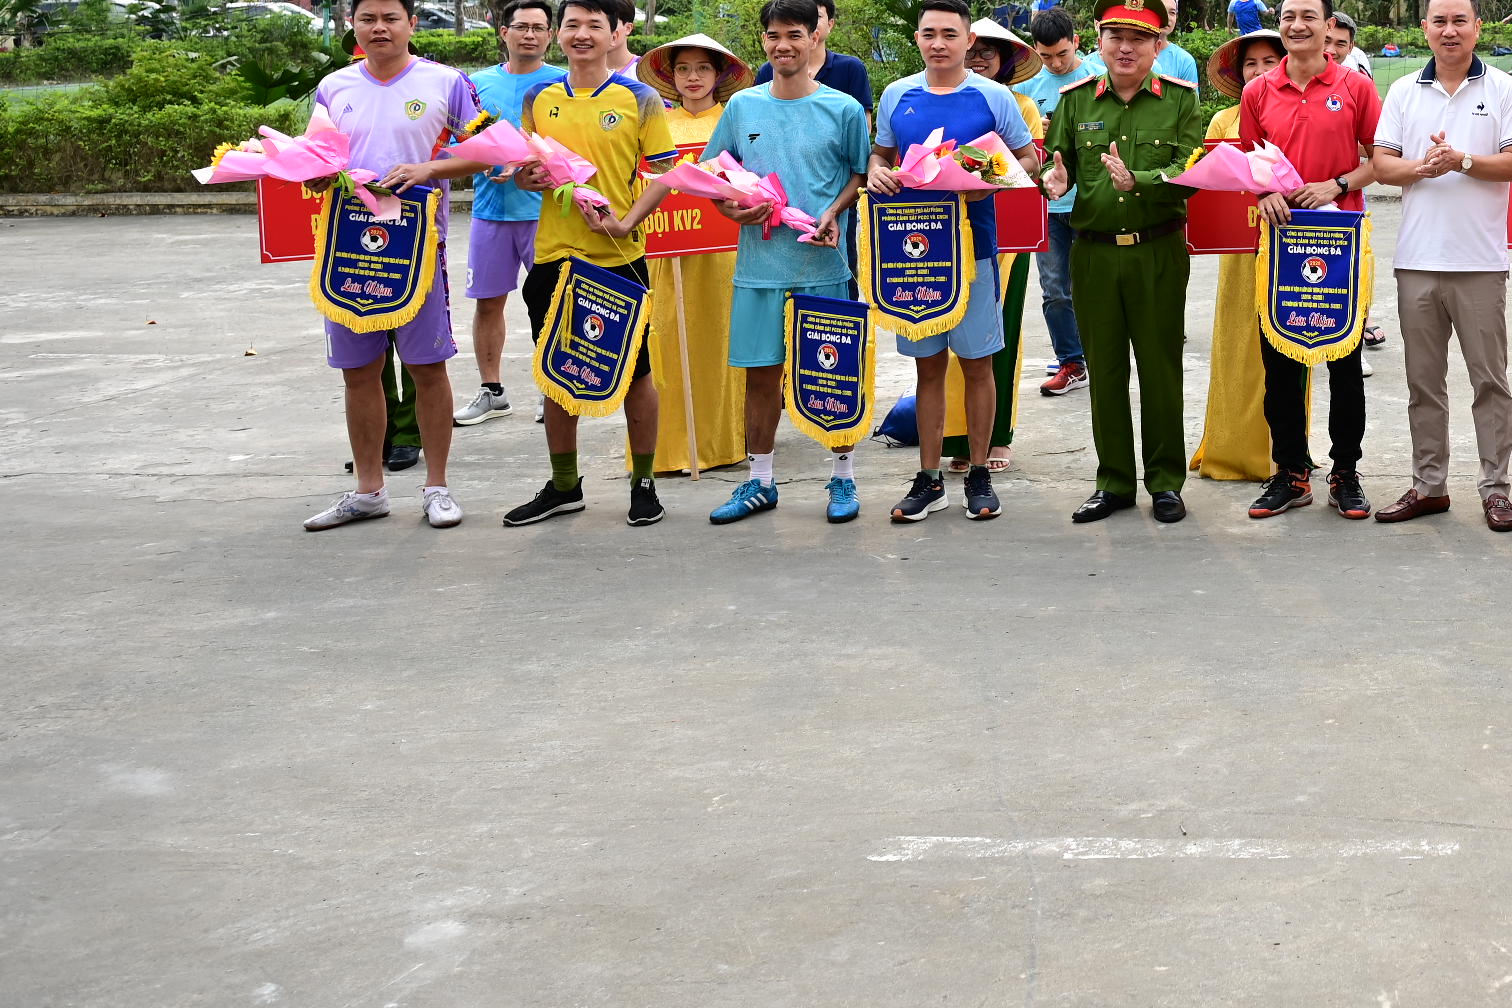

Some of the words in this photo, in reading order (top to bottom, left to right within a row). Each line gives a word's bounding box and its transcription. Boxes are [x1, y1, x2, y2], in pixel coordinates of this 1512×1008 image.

[349, 212, 367, 222] GIẢI
[673, 208, 702, 231] KV2
[888, 222, 905, 231] GIẢI
[906, 222, 930, 230] BÓNG
[930, 221, 943, 229] ĐÁ
[1288, 243, 1305, 254] GIẢI
[1305, 246, 1329, 255] BÓNG
[1329, 245, 1342, 255] ĐÁ
[578, 297, 592, 309] GIẢI
[591, 303, 610, 318] BÓNG
[609, 312, 619, 322] ĐÁ
[807, 331, 821, 340] GIẢI
[821, 333, 841, 343] BÓNG
[841, 336, 851, 344] ĐÁ
